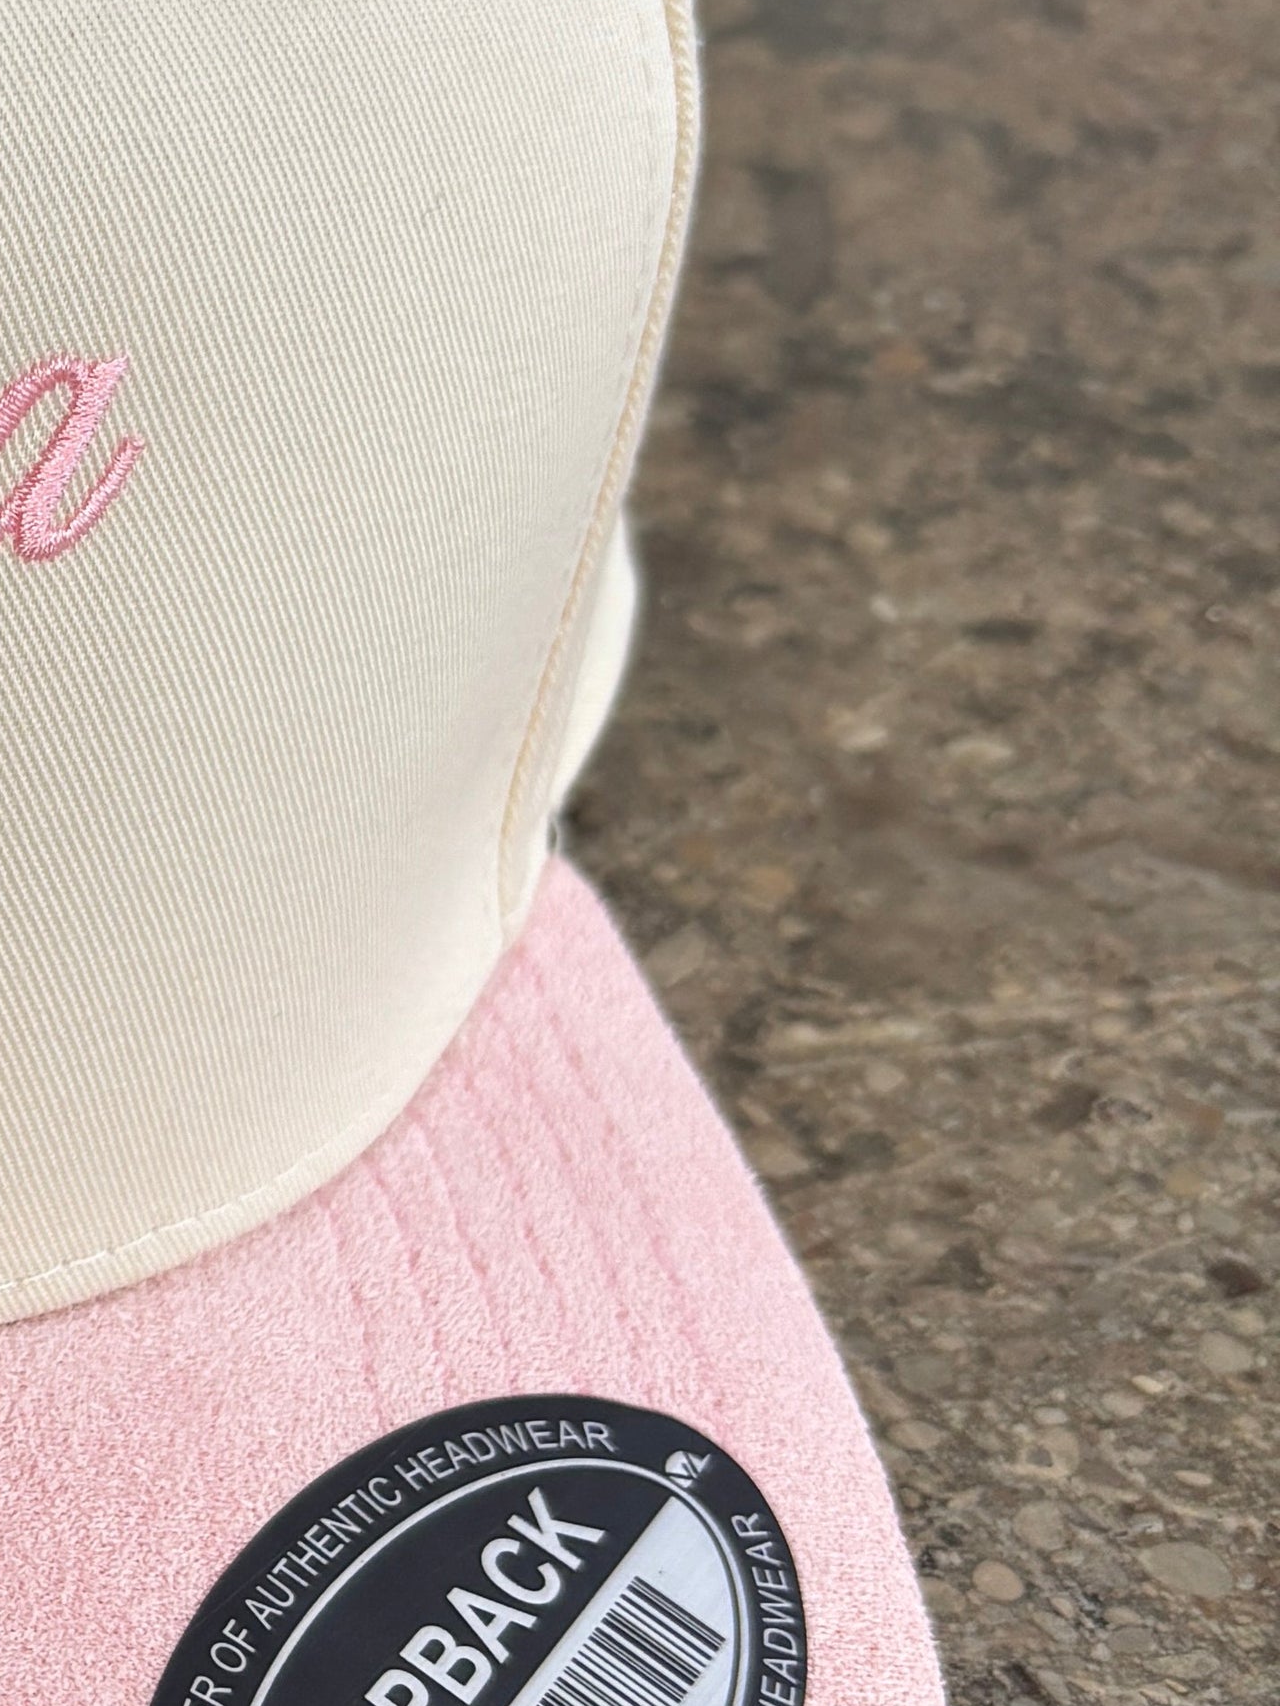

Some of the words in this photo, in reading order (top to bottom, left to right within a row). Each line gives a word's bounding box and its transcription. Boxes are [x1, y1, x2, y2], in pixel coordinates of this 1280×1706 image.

[210, 1619, 256, 1675] OF
[244, 1476, 402, 1630] AUTHENTIC
[399, 1421, 615, 1492] HEADWEAR
